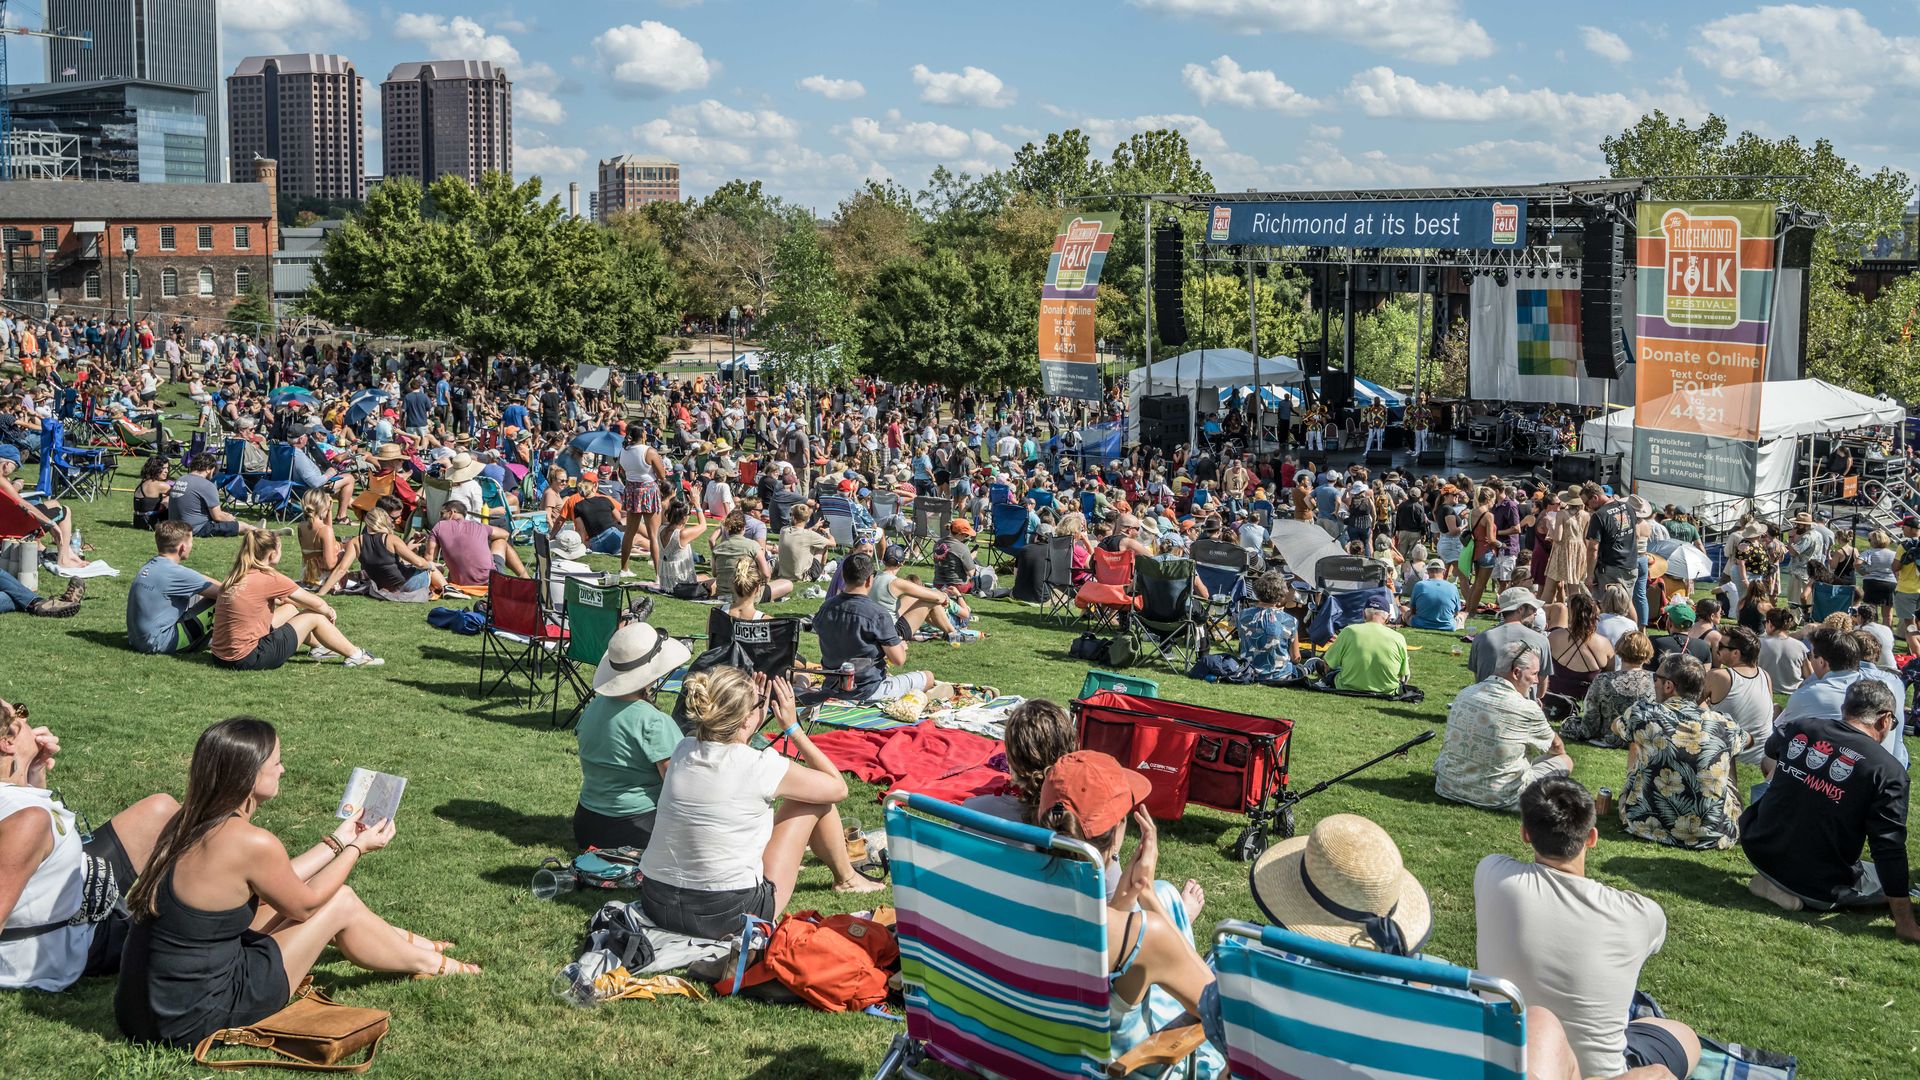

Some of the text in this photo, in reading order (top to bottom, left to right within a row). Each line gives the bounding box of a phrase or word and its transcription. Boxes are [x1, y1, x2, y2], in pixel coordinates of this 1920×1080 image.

[1252, 212, 1460, 236] Richmond at its best
[1495, 217, 1515, 231] FOLK
[1673, 228, 1733, 249] RICHMOND
[1061, 244, 1091, 269] FOLK
[1671, 255, 1733, 294] FOLK
[1043, 304, 1092, 316] Donate Online
[1675, 299, 1728, 309] FESTIVAL
[1054, 326, 1076, 337] FOLK
[1054, 342, 1077, 353] 44321
[1642, 347, 1760, 369] Donate Online
[1670, 369, 1727, 382] Text Code:
[1672, 379, 1724, 398] FOLK
[1670, 404, 1724, 422] 44321
[1648, 436, 1690, 447] #rvafolkfest
[1661, 447, 1743, 465] Richmond Folk Festival
[580, 587, 602, 602] DICK'S
[735, 624, 768, 639] DICK'S
[1776, 760, 1846, 801] PURE MADNESS
